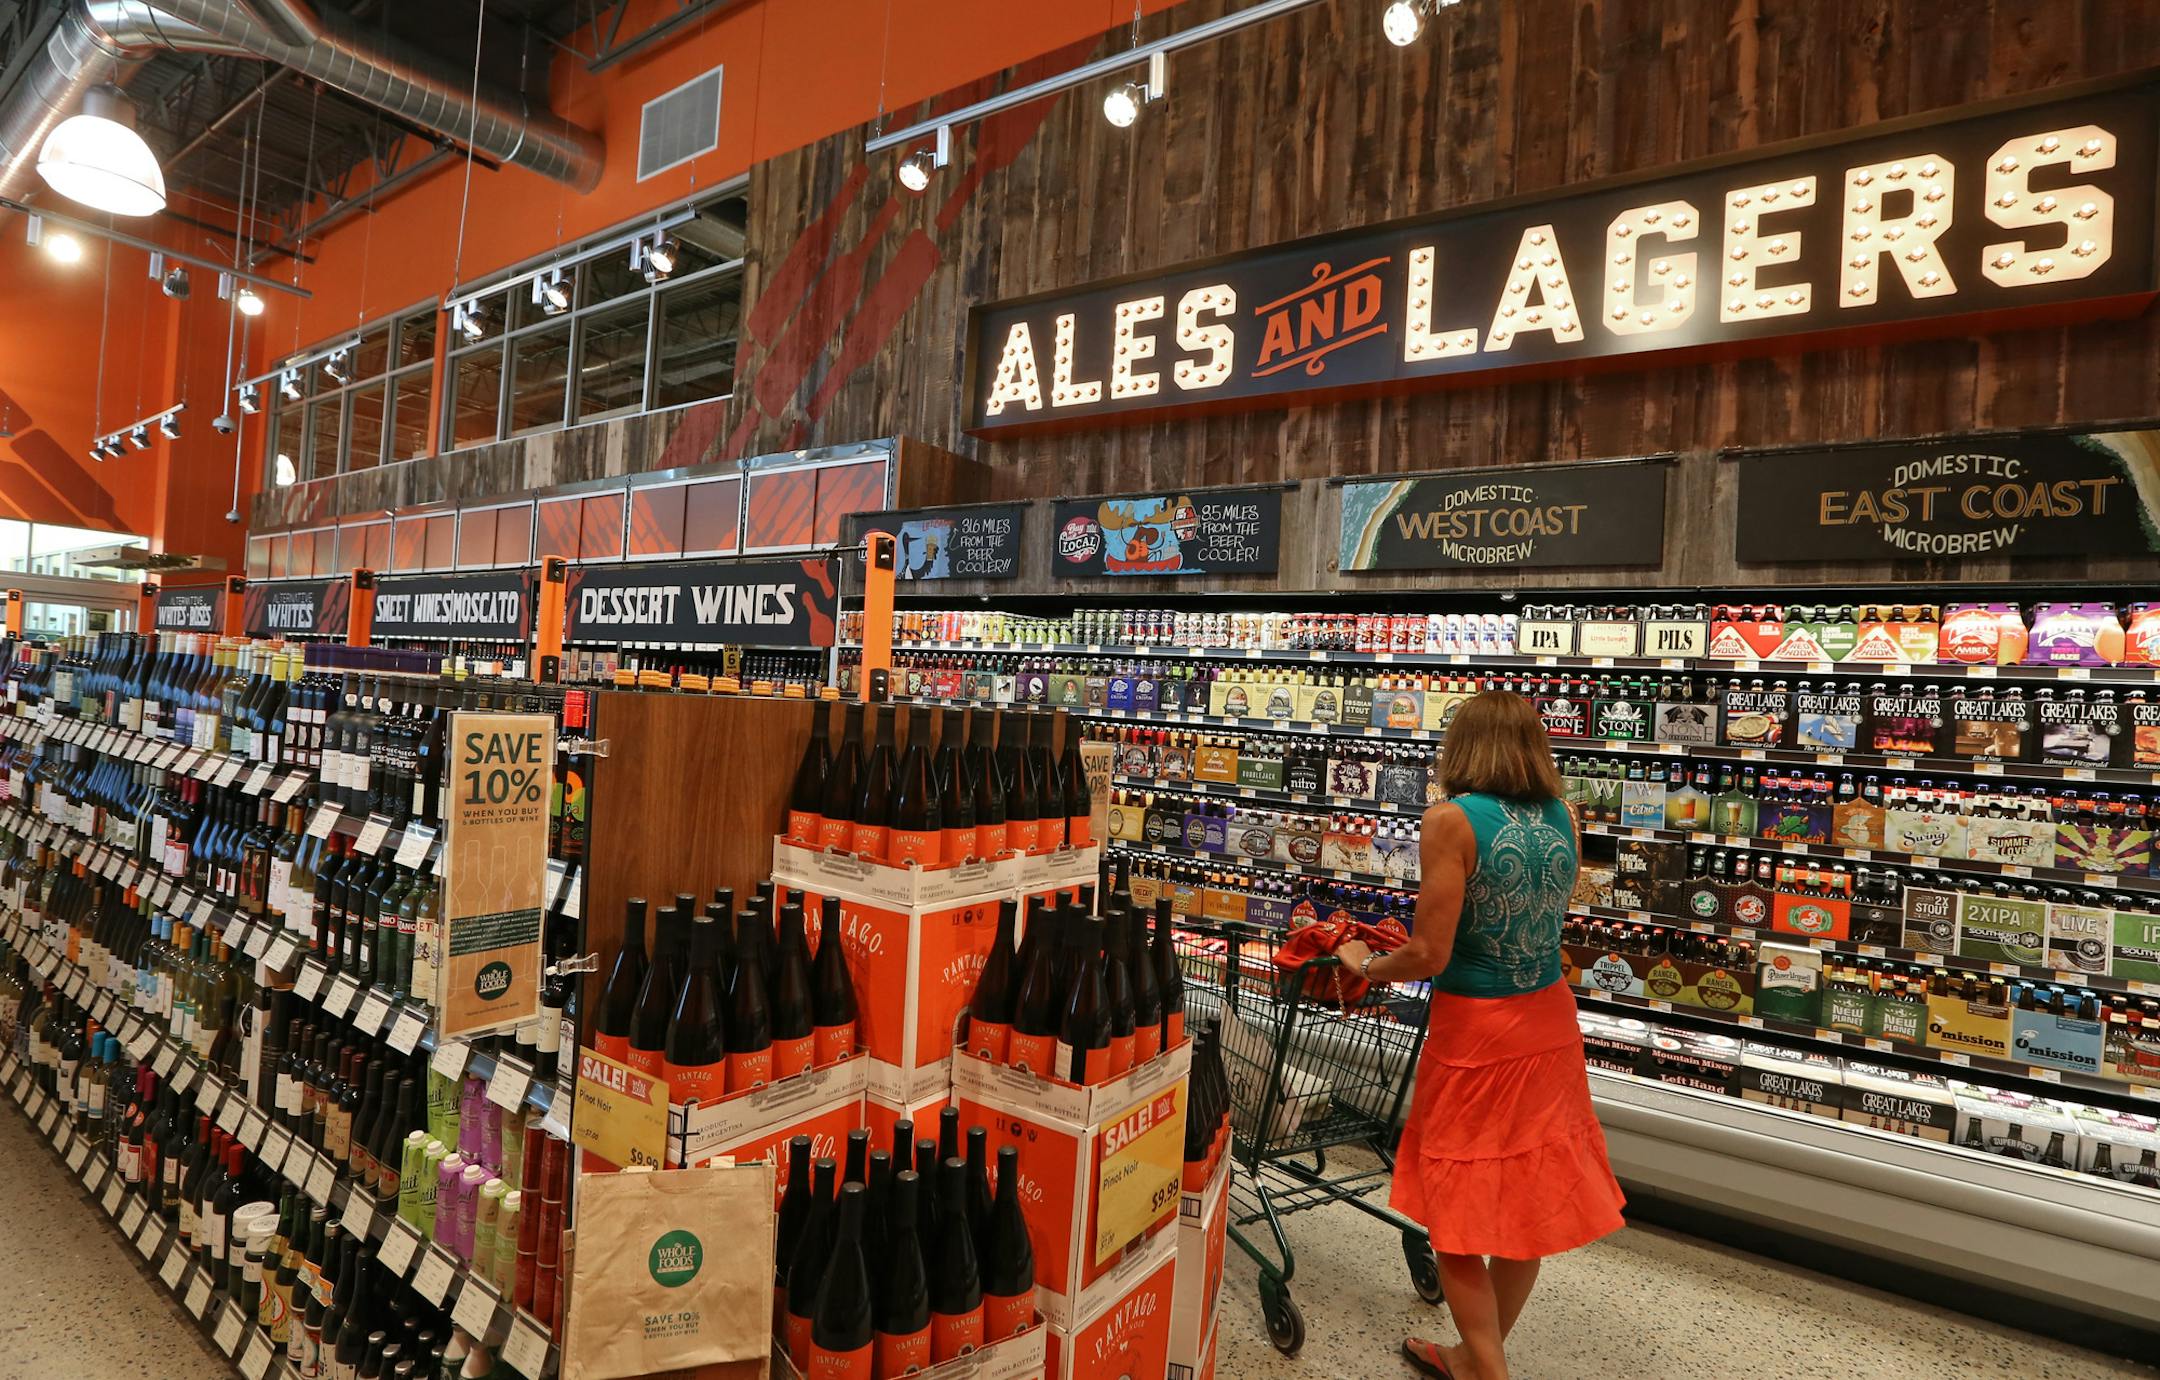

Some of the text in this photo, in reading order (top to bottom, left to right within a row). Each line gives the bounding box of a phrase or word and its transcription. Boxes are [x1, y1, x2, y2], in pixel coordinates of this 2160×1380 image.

[985, 124, 2117, 417] ALES AND LAGERS
[1894, 454, 2020, 488] DOMESTIC
[1444, 485, 1534, 512] DOMESTIC
[1819, 476, 2123, 525] EAST COAST
[1222, 504, 1259, 521] MILES
[983, 518, 1011, 534] MILES
[1202, 521, 1260, 535] FROM THE
[1396, 505, 1588, 540] WEST COAST
[960, 533, 1006, 548] FROM THE
[1061, 536, 1096, 553] LOCAL
[1209, 535, 1245, 550] BEER
[1884, 523, 2019, 554] MICROBREW
[967, 547, 995, 561] BEER
[1198, 545, 1260, 562] COOLER!
[1442, 538, 1534, 564] MICROBREW
[376, 593, 410, 623] SWEET
[579, 583, 797, 625] DESSERT WINES
[268, 603, 314, 628] WHITES
[1532, 630, 1559, 649] IPA
[1657, 629, 1693, 650] PILS
[728, 653, 736, 665] 6
[1954, 645, 1991, 656] AMBER
[1727, 693, 1786, 707] GREAT LAKES
[1797, 695, 1861, 711] GREAT LAKES
[1873, 697, 1941, 715] GREAT LAKES
[1954, 699, 2026, 717] GREAT LAKES
[1346, 706, 1370, 715] STOUT
[2040, 702, 2118, 720] GREAT LAKES
[1597, 719, 1646, 739] STONE
[1657, 724, 1714, 742] STONE
[464, 732, 543, 764] SAVE
[1084, 755, 1109, 773] SAVE
[464, 768, 541, 805] 10%
[1087, 774, 1107, 795] 0%
[1290, 777, 1317, 789] nitro
[463, 807, 539, 818] WHEN YOU BUY
[1619, 853, 1638, 863] BACK
[1626, 861, 1648, 871] BLACK
[1613, 889, 1633, 898] BACK
[1934, 896, 1949, 906] 2X
[1620, 898, 1642, 908] BLACK
[1915, 902, 1949, 916] STOUT
[1967, 905, 2021, 926] 2XIPA
[2061, 914, 2098, 934] LIVE
[1600, 961, 1625, 972] TRIPPEL
[1652, 969, 1678, 979] RANGER
[480, 970, 508, 982] WHOLE
[480, 978, 507, 990] FOODS
[1706, 978, 1734, 989] RANGER
[1831, 1014, 1864, 1027] PLANET
[1832, 1006, 1864, 1019] NEW
[1884, 1014, 1918, 1028] NEW
[1883, 1023, 1916, 1037] PLANET
[1929, 1023, 2006, 1049] Omission
[1582, 1037, 1642, 1053] untain Mixer
[2015, 1038, 2097, 1065] Omission
[1600, 1061, 1634, 1075] Hand
[1652, 1050, 1735, 1073] Mountain Mixer
[582, 1056, 628, 1093] SALE!
[1660, 1073, 1726, 1094] Left Hand
[1759, 1072, 1823, 1098] GREAT LAKES
[579, 1089, 612, 1113] Pinot Noir
[1862, 1092, 1932, 1120] GREAT LAKES
[1105, 1102, 1153, 1156] SALE!
[1993, 1137, 2036, 1153] SUPER PACK
[630, 1147, 659, 1171] $9.99
[1103, 1159, 1139, 1191] Pinot Noir
[2125, 1164, 2149, 1176] SUPER
[1151, 1178, 1179, 1213] $9.99
[657, 1245, 696, 1258] WHOLE
[659, 1256, 694, 1268] FOODS
[644, 1312, 701, 1327] SAVE 10%
[644, 1326, 666, 1334] WHEN
[685, 1321, 699, 1329] BUY
